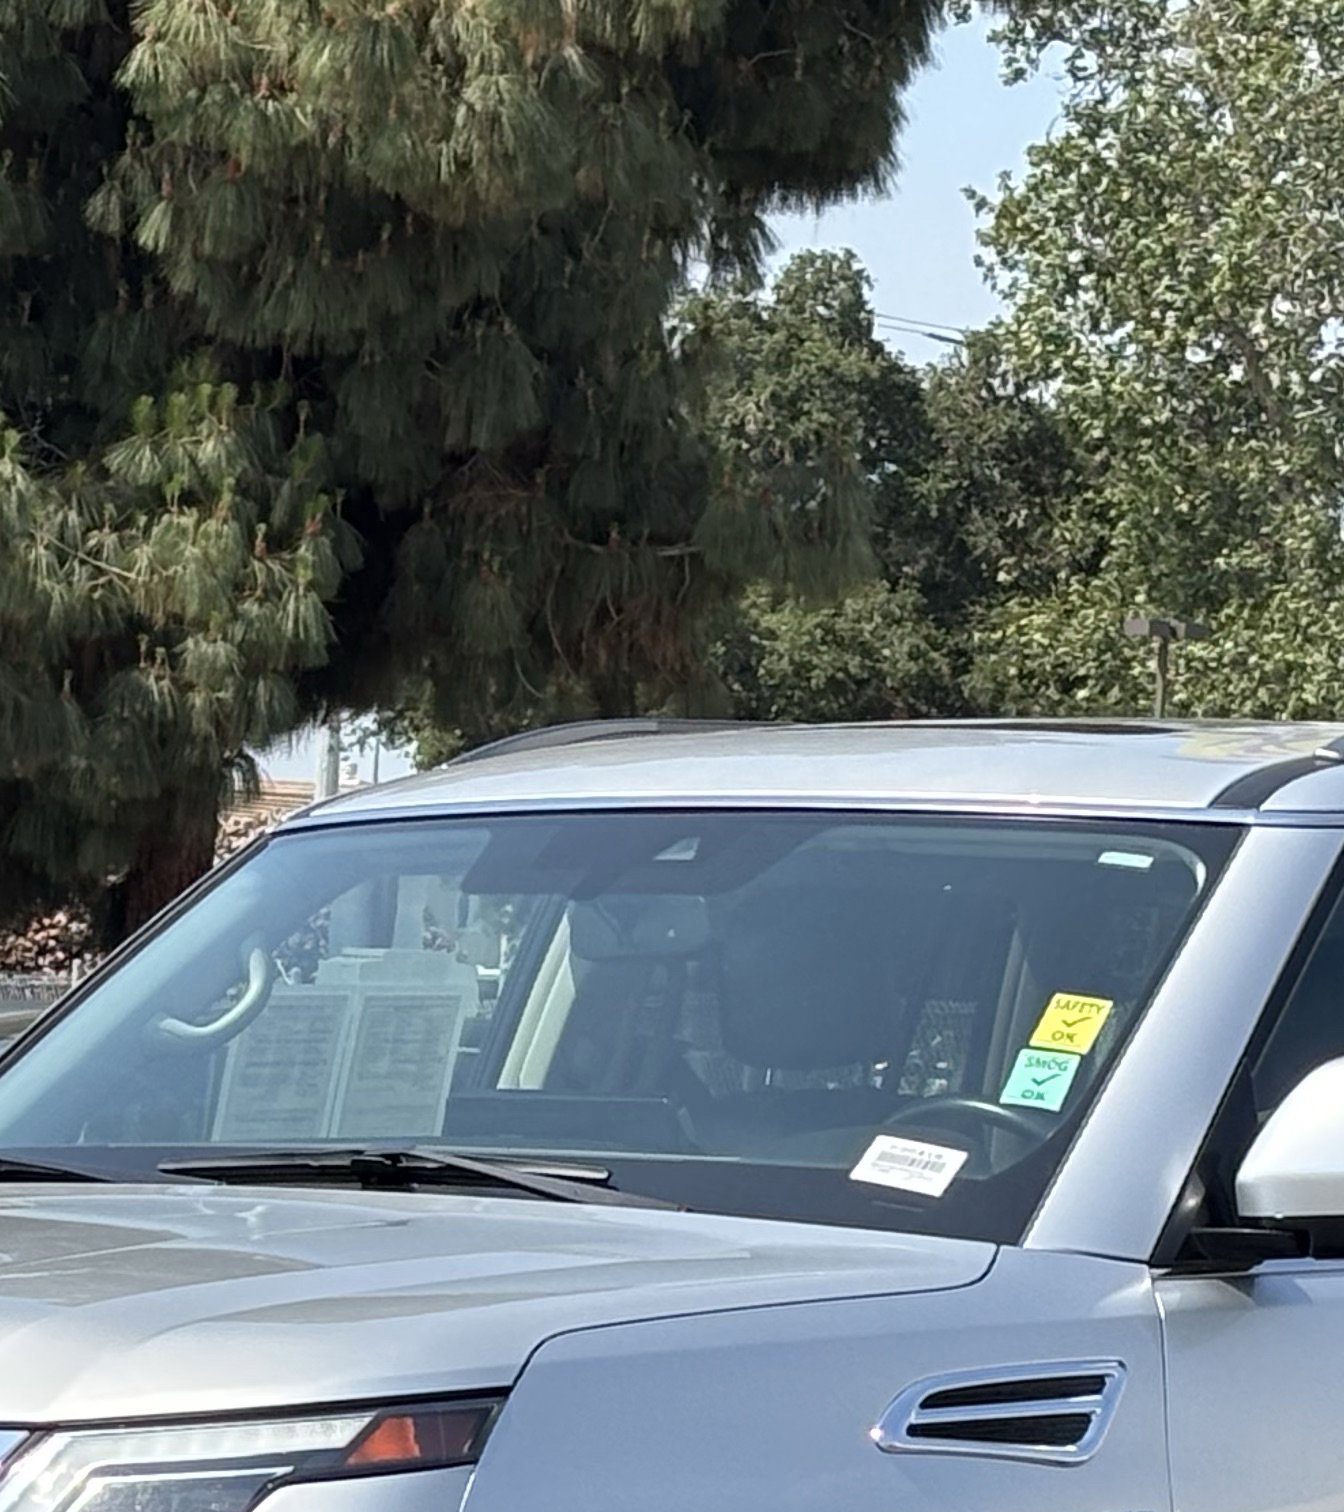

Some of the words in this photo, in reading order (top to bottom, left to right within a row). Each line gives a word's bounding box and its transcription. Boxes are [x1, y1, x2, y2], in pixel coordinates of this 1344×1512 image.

[1054, 998, 1106, 1014] SAFETY
[1051, 1030, 1077, 1044] OK
[1024, 1055, 1070, 1072] SMOG
[1020, 1089, 1046, 1101] OK
